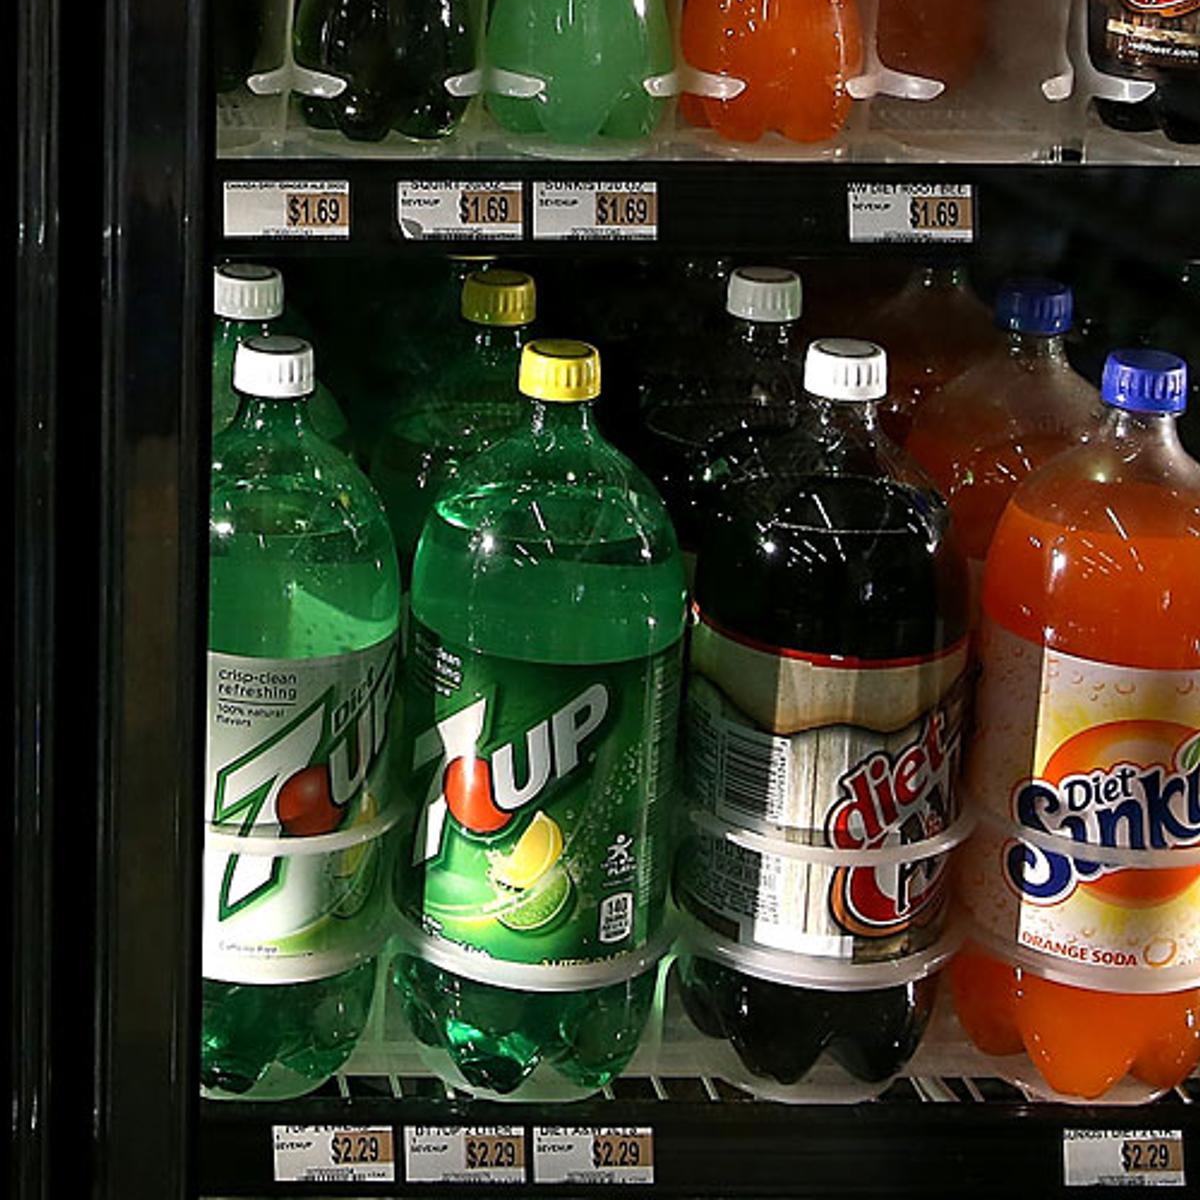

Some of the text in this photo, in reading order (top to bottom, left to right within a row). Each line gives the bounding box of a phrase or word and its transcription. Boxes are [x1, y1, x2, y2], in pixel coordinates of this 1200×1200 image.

[288, 197, 339, 225] $1.69
[460, 194, 509, 224] $1.69
[596, 196, 647, 224] $1.69
[910, 200, 958, 228] $1.69
[218, 683, 297, 701] refreshing
[490, 682, 611, 812] UP
[832, 708, 947, 851] diet
[1065, 768, 1135, 814] Diet
[1008, 766, 1200, 899] Sunk
[1022, 929, 1139, 968] ORANGE SODA
[331, 1136, 378, 1164] $2.29
[466, 1141, 515, 1169] $2.29
[593, 1140, 640, 1168] $2.29
[1122, 1141, 1169, 1171] $2.29
